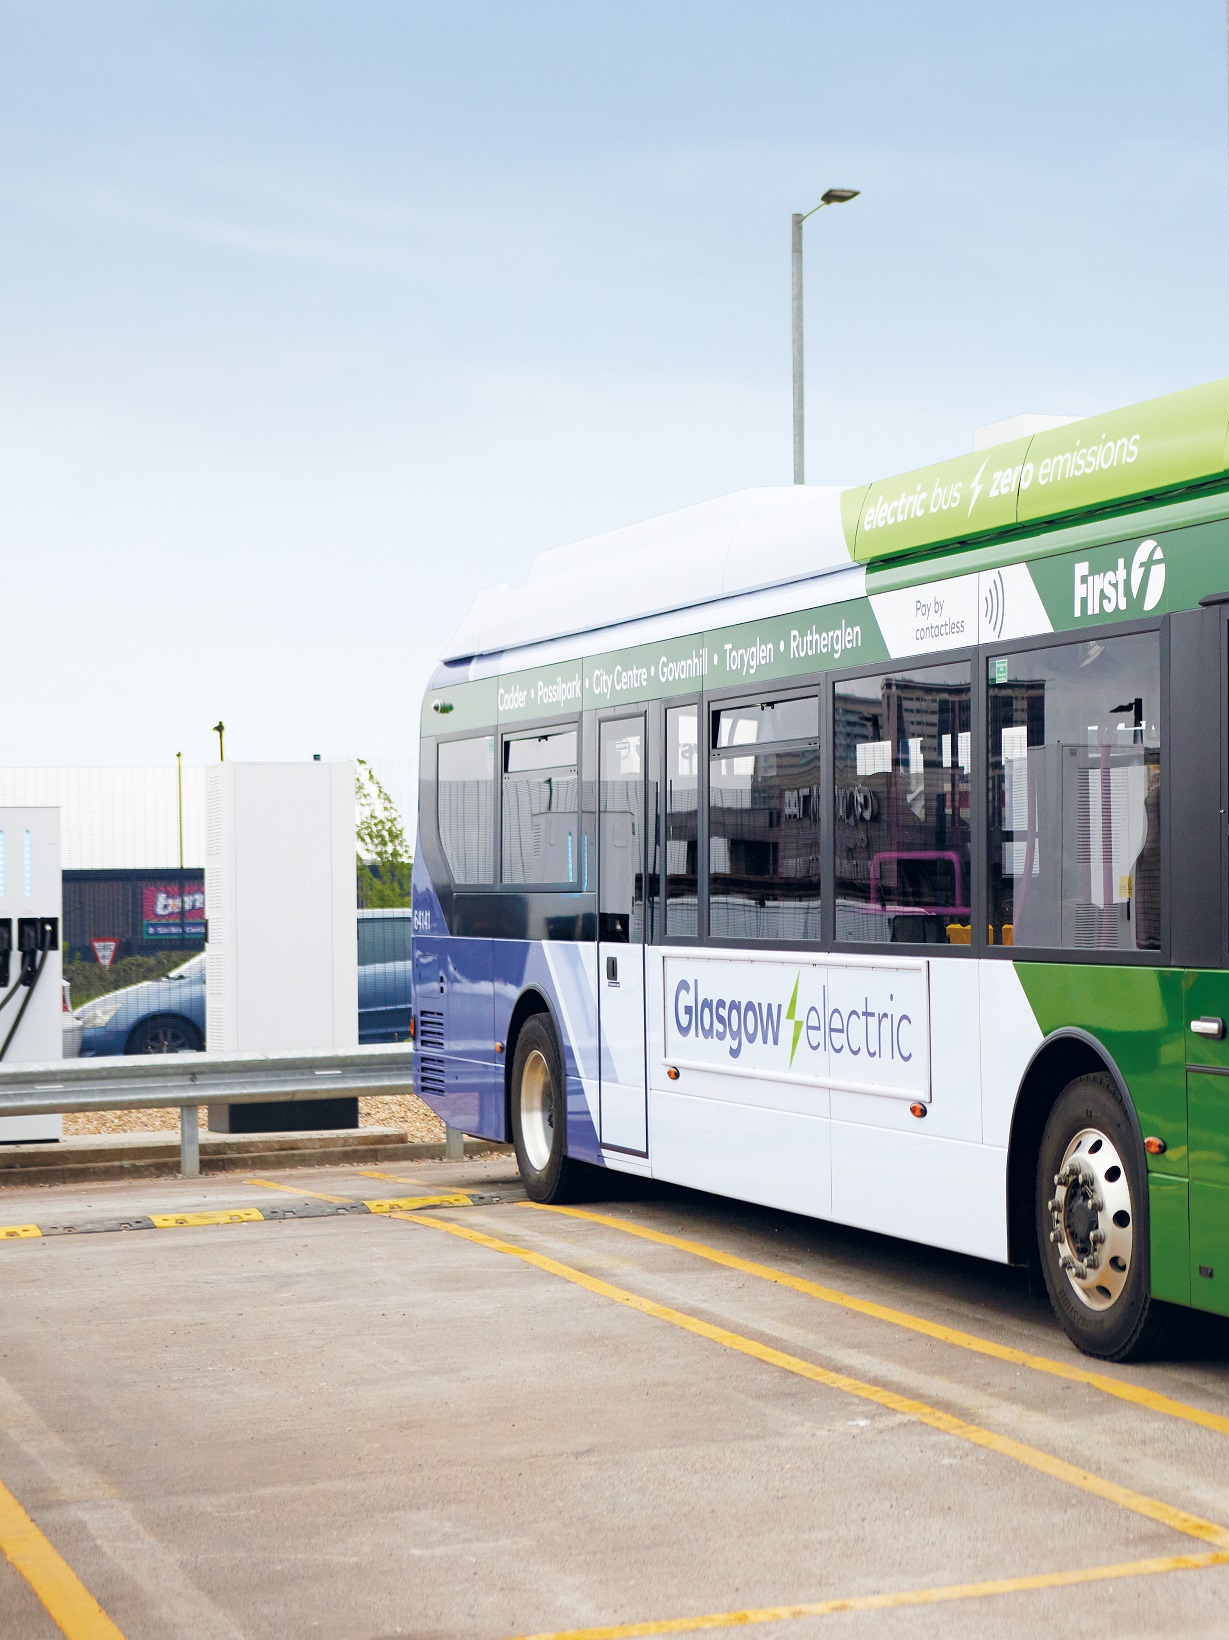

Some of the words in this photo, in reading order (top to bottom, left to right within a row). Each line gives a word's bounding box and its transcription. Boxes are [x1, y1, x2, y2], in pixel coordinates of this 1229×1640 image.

[864, 483, 928, 532] electric
[929, 478, 962, 514] bus
[988, 461, 1034, 498] zero
[1038, 433, 1141, 486] emissions
[915, 599, 932, 618] Pay
[934, 595, 945, 615] by
[1073, 557, 1127, 618] First
[915, 617, 965, 641] contactless
[498, 685, 527, 711] Cadder
[537, 673, 582, 707] Possilpark
[592, 669, 613, 699] City
[614, 665, 648, 691] Centre
[658, 647, 708, 683] Govanhill
[724, 637, 774, 676] Toryglen
[790, 619, 862, 659] Rutherglen
[414, 909, 431, 930] 64141
[674, 978, 783, 1059] Glasgow
[806, 984, 913, 1062] electric
